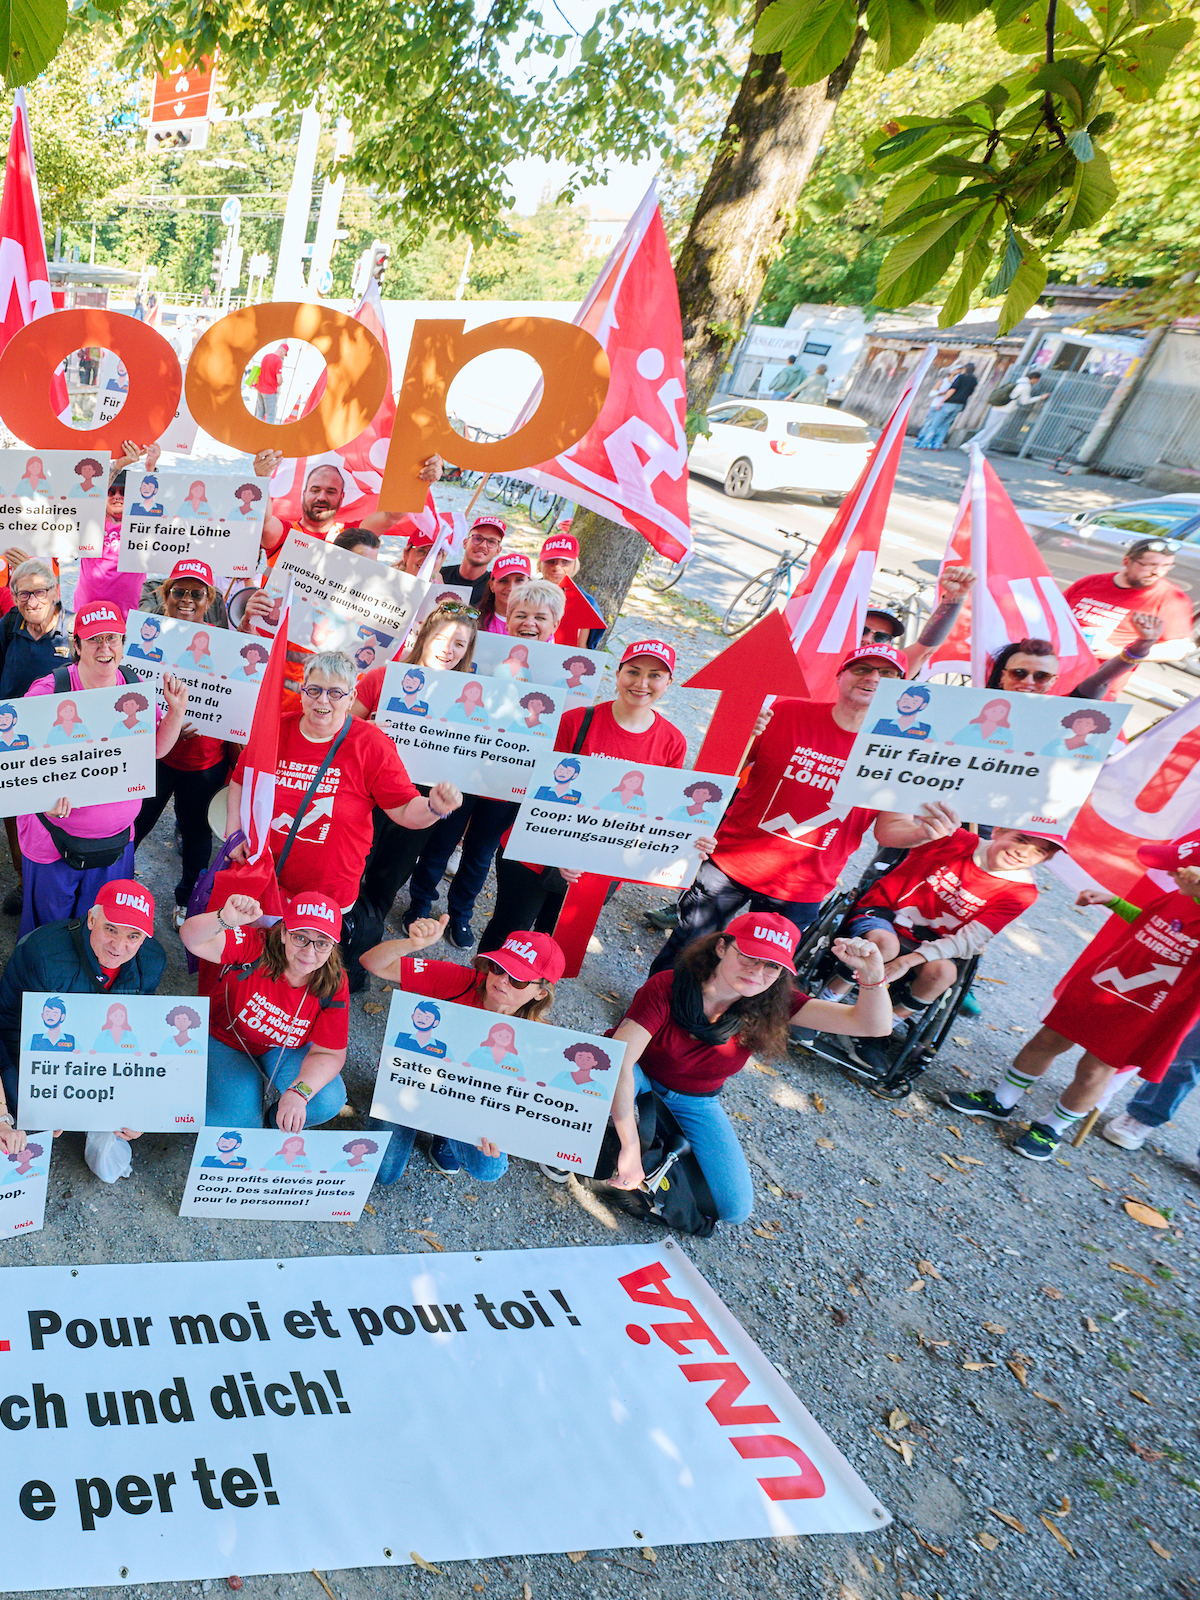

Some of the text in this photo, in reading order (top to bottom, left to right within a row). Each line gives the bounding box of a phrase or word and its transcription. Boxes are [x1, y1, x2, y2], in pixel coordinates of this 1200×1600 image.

[0, 504, 22, 514] des
[26, 503, 77, 516] salaires
[8, 520, 38, 531] chez
[129, 522, 231, 538] Für faire Löhne
[127, 539, 190, 555] bei Coop!
[385, 719, 530, 753] Satte Gewinne für Coop.
[29, 756, 57, 767] des
[61, 747, 122, 763] salaires
[413, 738, 450, 753] Löhne
[453, 745, 477, 758] fürs
[865, 743, 1040, 777] Für faire Löhne
[42, 771, 77, 783] chez
[856, 764, 965, 792] bei Coop!
[530, 807, 692, 840] Coop: Wo bleibt unser
[525, 821, 679, 854] Teuerungsausgleich?
[31, 1060, 167, 1078] Für faire Löhne
[30, 1084, 115, 1103] bei Coop!
[392, 1057, 579, 1113] Satte Gewinne für Coop.
[390, 1072, 593, 1133] Faire Löhne fürs Personal!
[199, 1173, 224, 1182] Des
[226, 1175, 269, 1183] profits
[272, 1176, 313, 1185] élevés
[196, 1184, 355, 1197] Coop. Des salaires justes
[225, 1196, 238, 1204] le
[27, 1309, 153, 1351] Pour
[169, 1301, 271, 1346] moi
[283, 1300, 342, 1341] et
[347, 1303, 468, 1346] pour
[85, 1376, 195, 1428] und
[209, 1369, 352, 1420] dich!
[18, 1479, 57, 1521] e
[75, 1471, 177, 1532] per
[190, 1452, 280, 1510] te!
